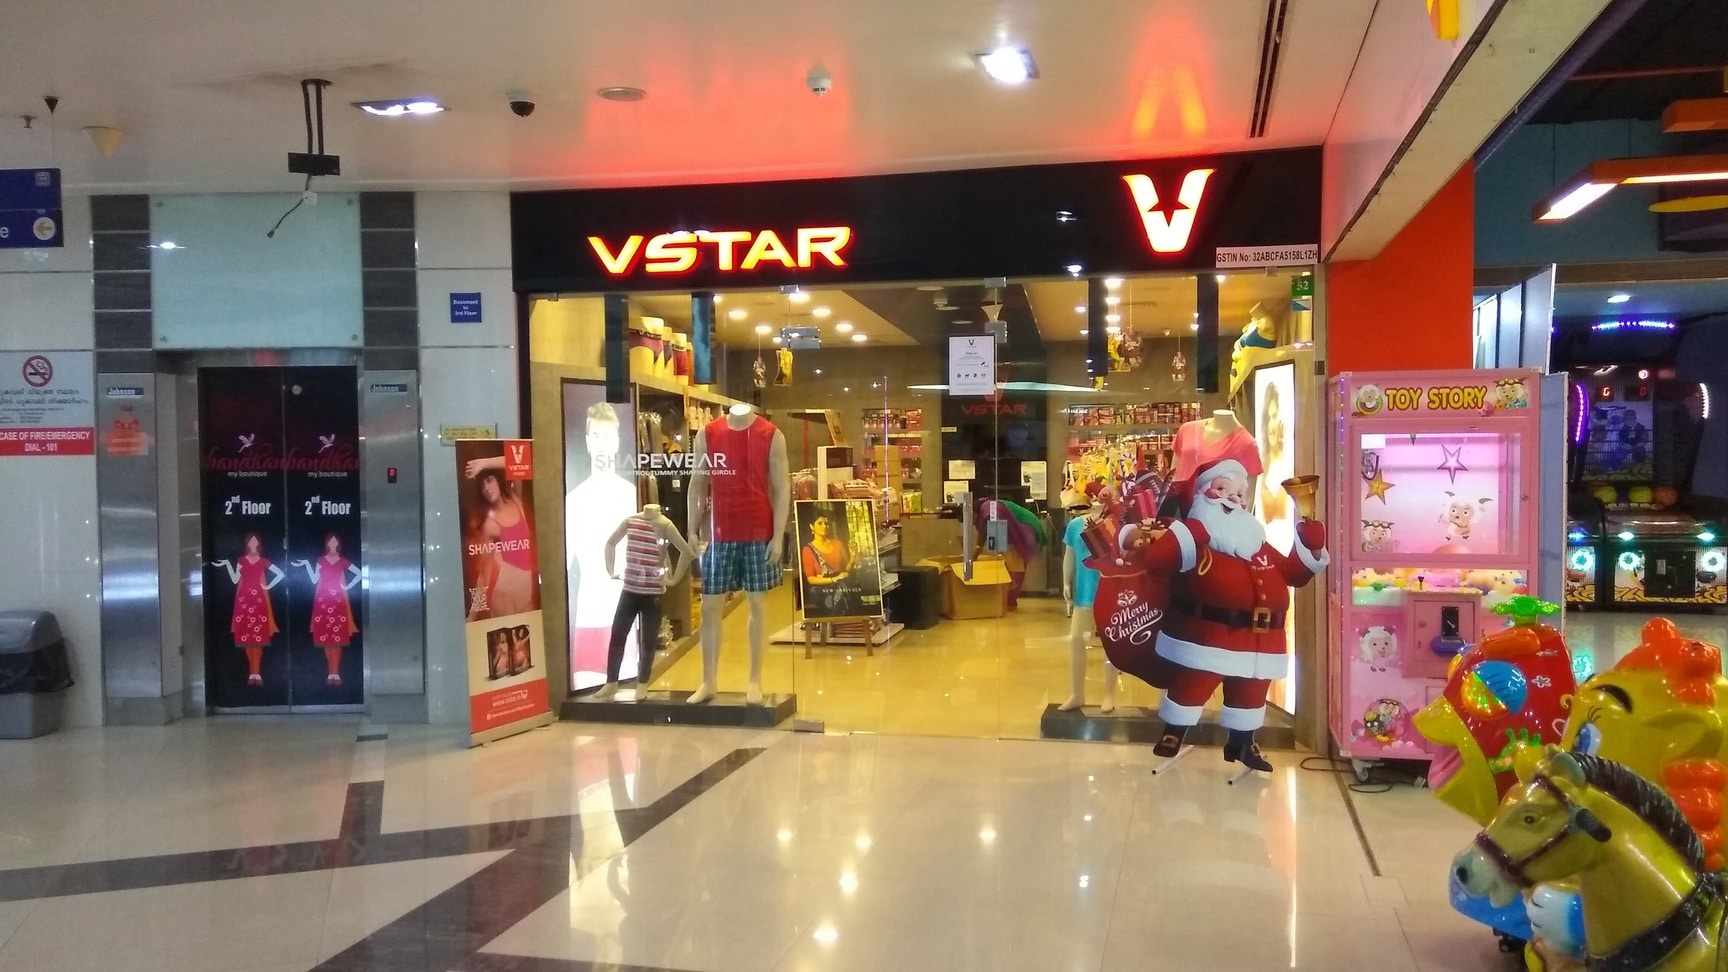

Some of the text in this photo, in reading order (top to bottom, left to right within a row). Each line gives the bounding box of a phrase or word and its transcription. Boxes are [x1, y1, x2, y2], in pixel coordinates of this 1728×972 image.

[587, 226, 851, 274] VSTAR
[1216, 253, 1238, 263] GSTIN
[1239, 252, 1251, 262] No:
[1385, 385, 1488, 411] TOY STORY
[960, 402, 1028, 416] VSTAR
[18, 431, 29, 440] OF
[24, 442, 41, 452] DIAL
[46, 442, 58, 451] 101
[595, 452, 727, 470] SHAPEWEAR
[225, 495, 272, 515] 2nd Floor
[304, 495, 351, 515] 2nd Floor
[468, 538, 530, 556] SHAPEWEAR
[1110, 601, 1149, 625] Merry
[1104, 607, 1163, 645] Christmas
